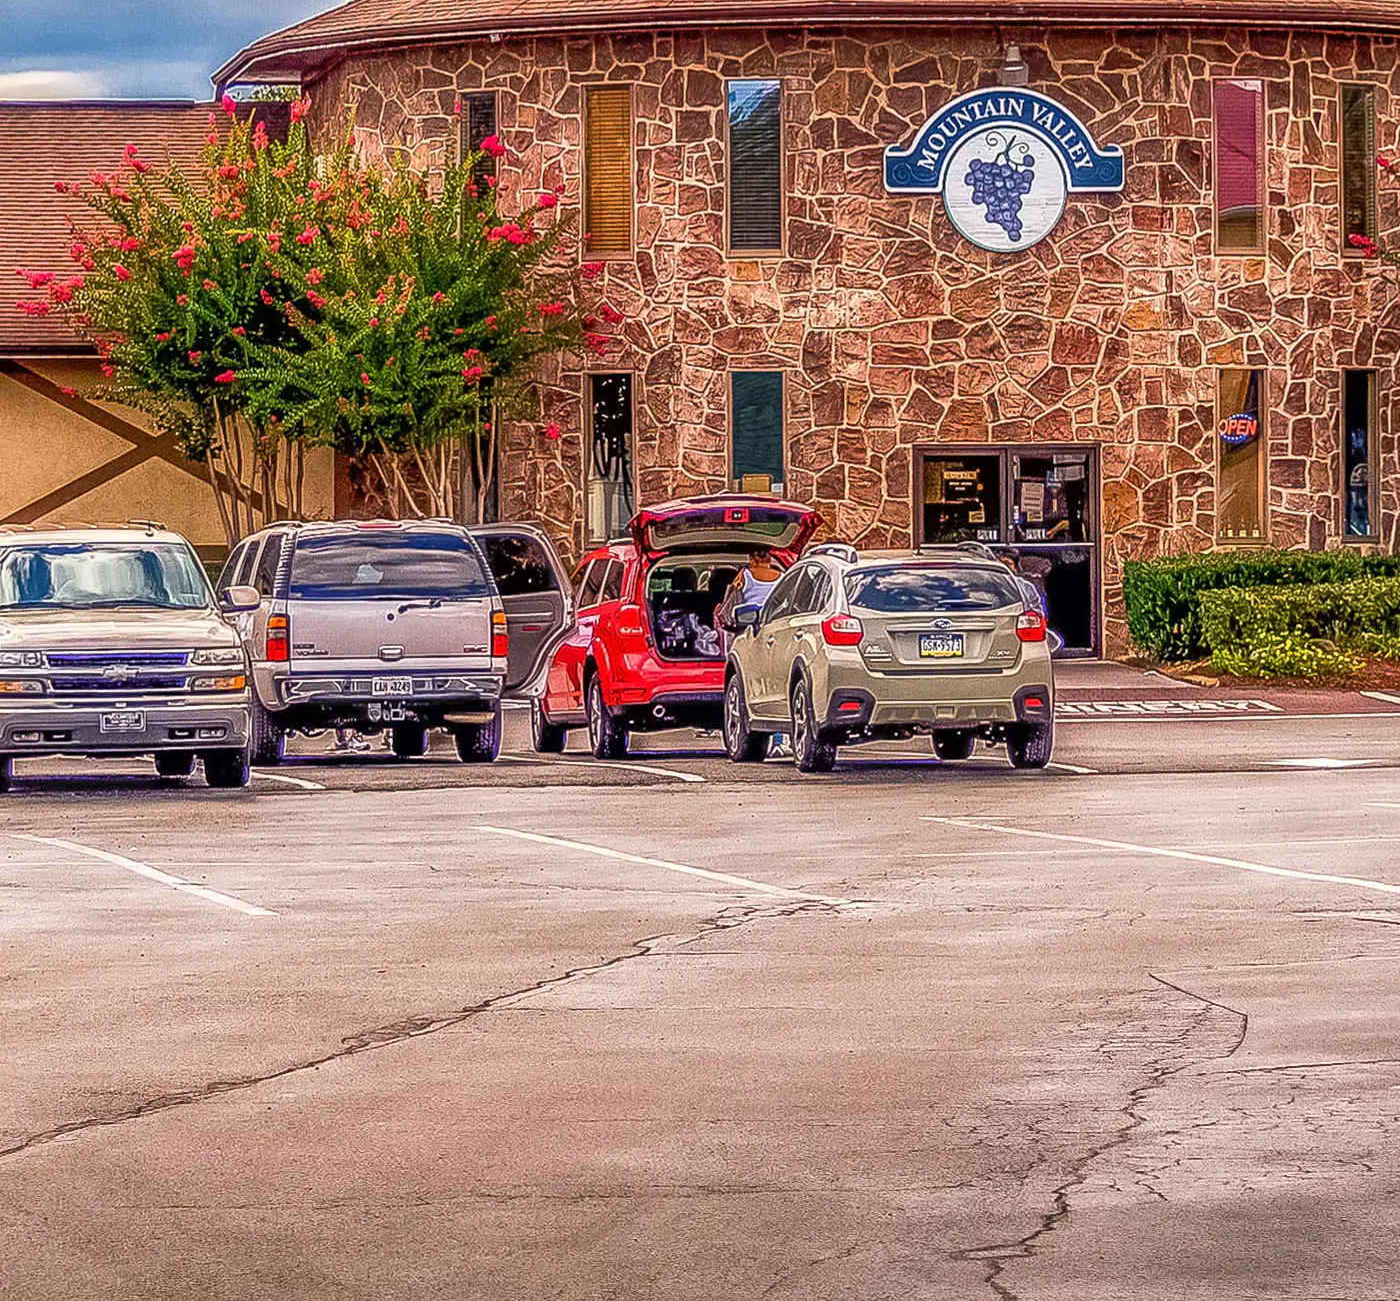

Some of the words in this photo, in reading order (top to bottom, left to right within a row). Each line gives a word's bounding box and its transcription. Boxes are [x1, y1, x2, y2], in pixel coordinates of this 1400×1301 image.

[917, 98, 1026, 172] MOUNTAIN
[1032, 101, 1094, 171] VALLEY
[1217, 418, 1258, 437] OPEN
